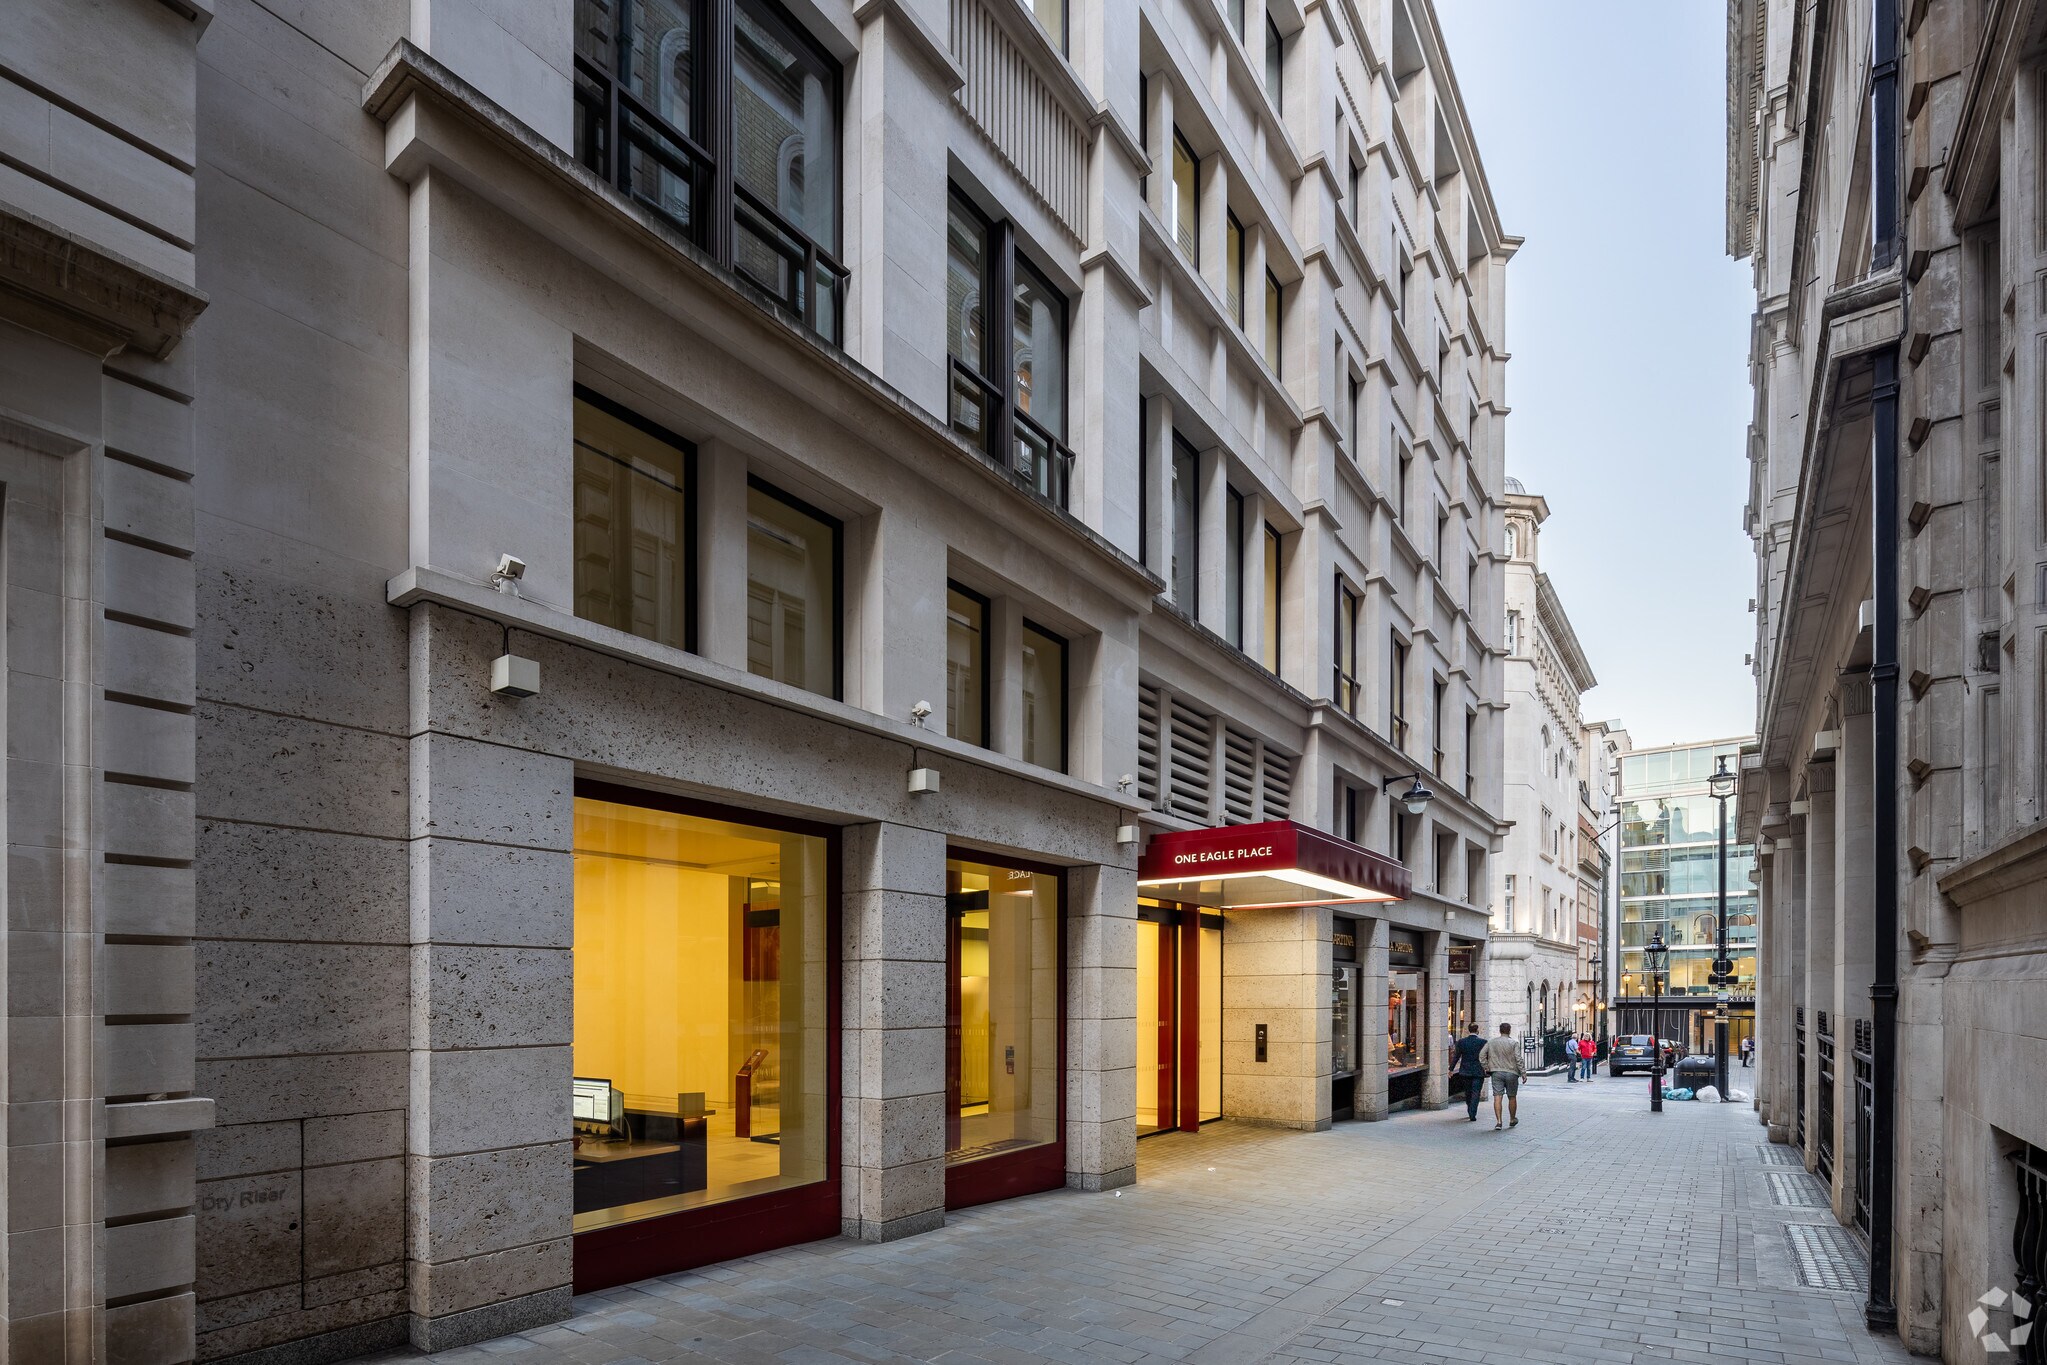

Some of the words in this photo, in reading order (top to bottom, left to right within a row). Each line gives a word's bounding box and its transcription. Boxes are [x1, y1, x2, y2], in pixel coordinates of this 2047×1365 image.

[1174, 853, 1197, 864] ONE
[1200, 850, 1234, 862] EAGLE
[1237, 846, 1273, 858] PLACE
[1333, 933, 1354, 947] ARTINA
[202, 1196, 234, 1211] Dry
[240, 1189, 286, 1208] Riser
